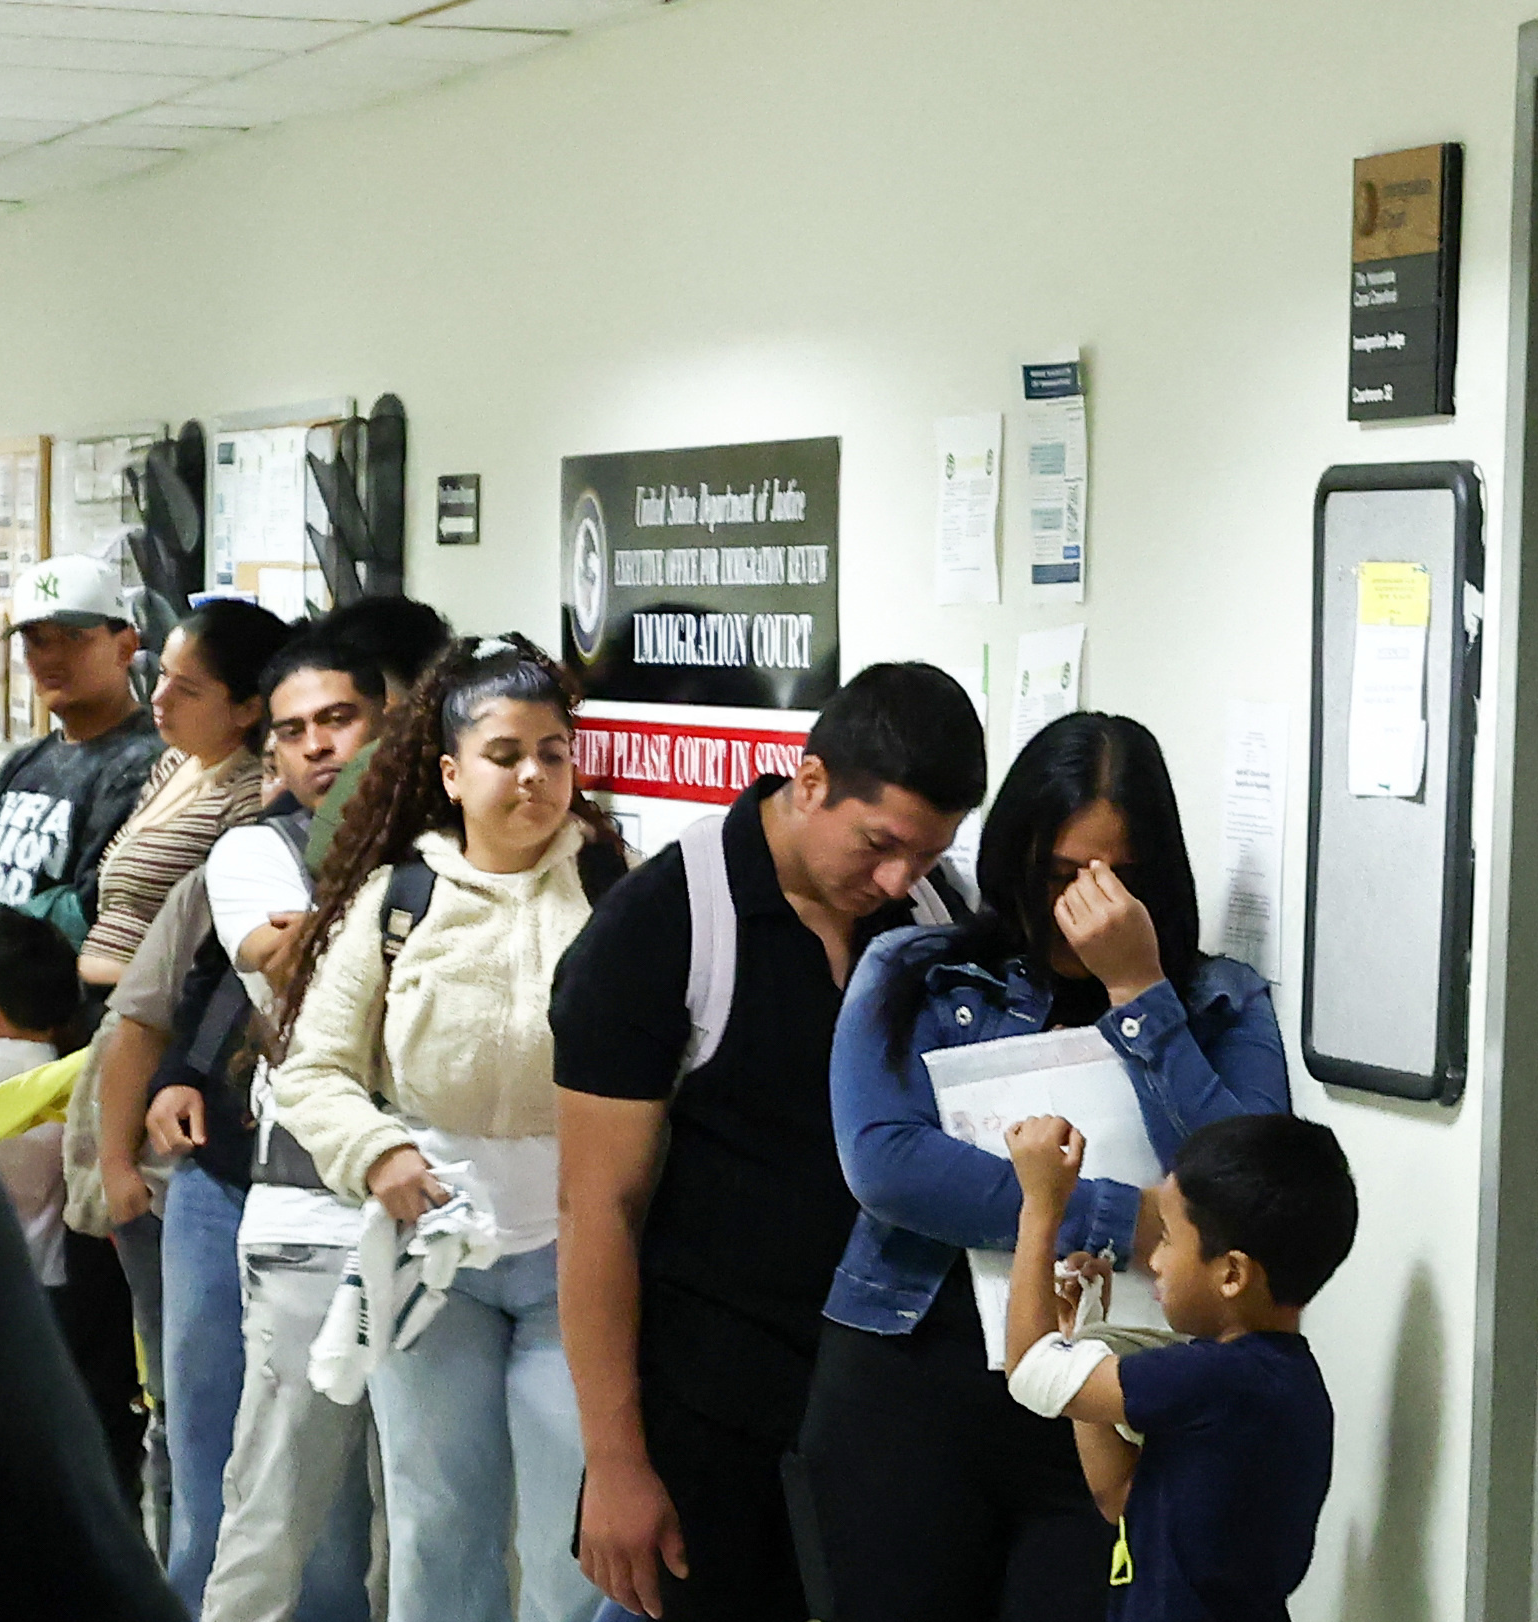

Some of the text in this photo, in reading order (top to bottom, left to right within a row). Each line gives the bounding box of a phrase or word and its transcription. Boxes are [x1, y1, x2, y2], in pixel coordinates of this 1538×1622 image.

[699, 481, 755, 533] Department
[34, 572, 60, 601] NY
[633, 613, 814, 669] IMMIGRATION COURT
[572, 728, 609, 776] UIET
[612, 731, 671, 783] PLEASE
[673, 735, 728, 788] COURT
[729, 740, 751, 790] IN
